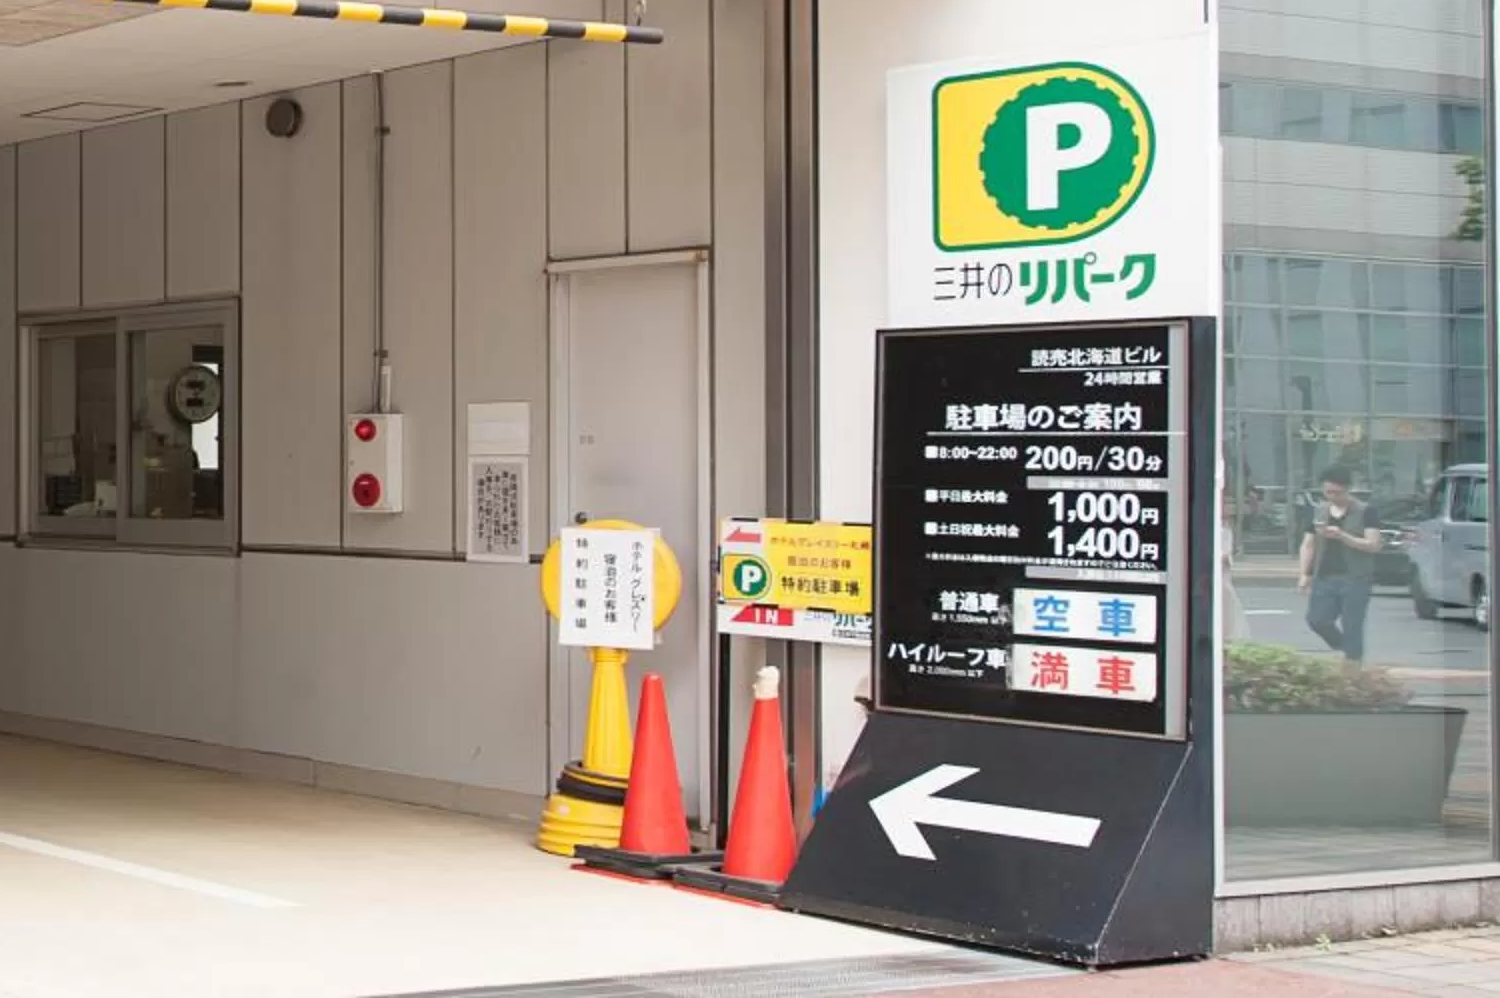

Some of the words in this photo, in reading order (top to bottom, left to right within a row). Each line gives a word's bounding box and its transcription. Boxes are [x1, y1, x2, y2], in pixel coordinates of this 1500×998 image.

[1025, 101, 1113, 211] P
[933, 252, 1156, 306] 三井のリパーク
[1031, 346, 1162, 367] 読売北海道ビル
[1084, 370, 1162, 386] 24時間営業
[945, 402, 1142, 431] 駐車場のご案内
[1048, 491, 1159, 525] 1,000円
[1048, 525, 1159, 560] 1,400円
[939, 590, 999, 612] 普通車
[1032, 595, 1136, 637] 空車
[888, 642, 1006, 669] ハイルーフ車
[1030, 652, 1136, 694] 満車
